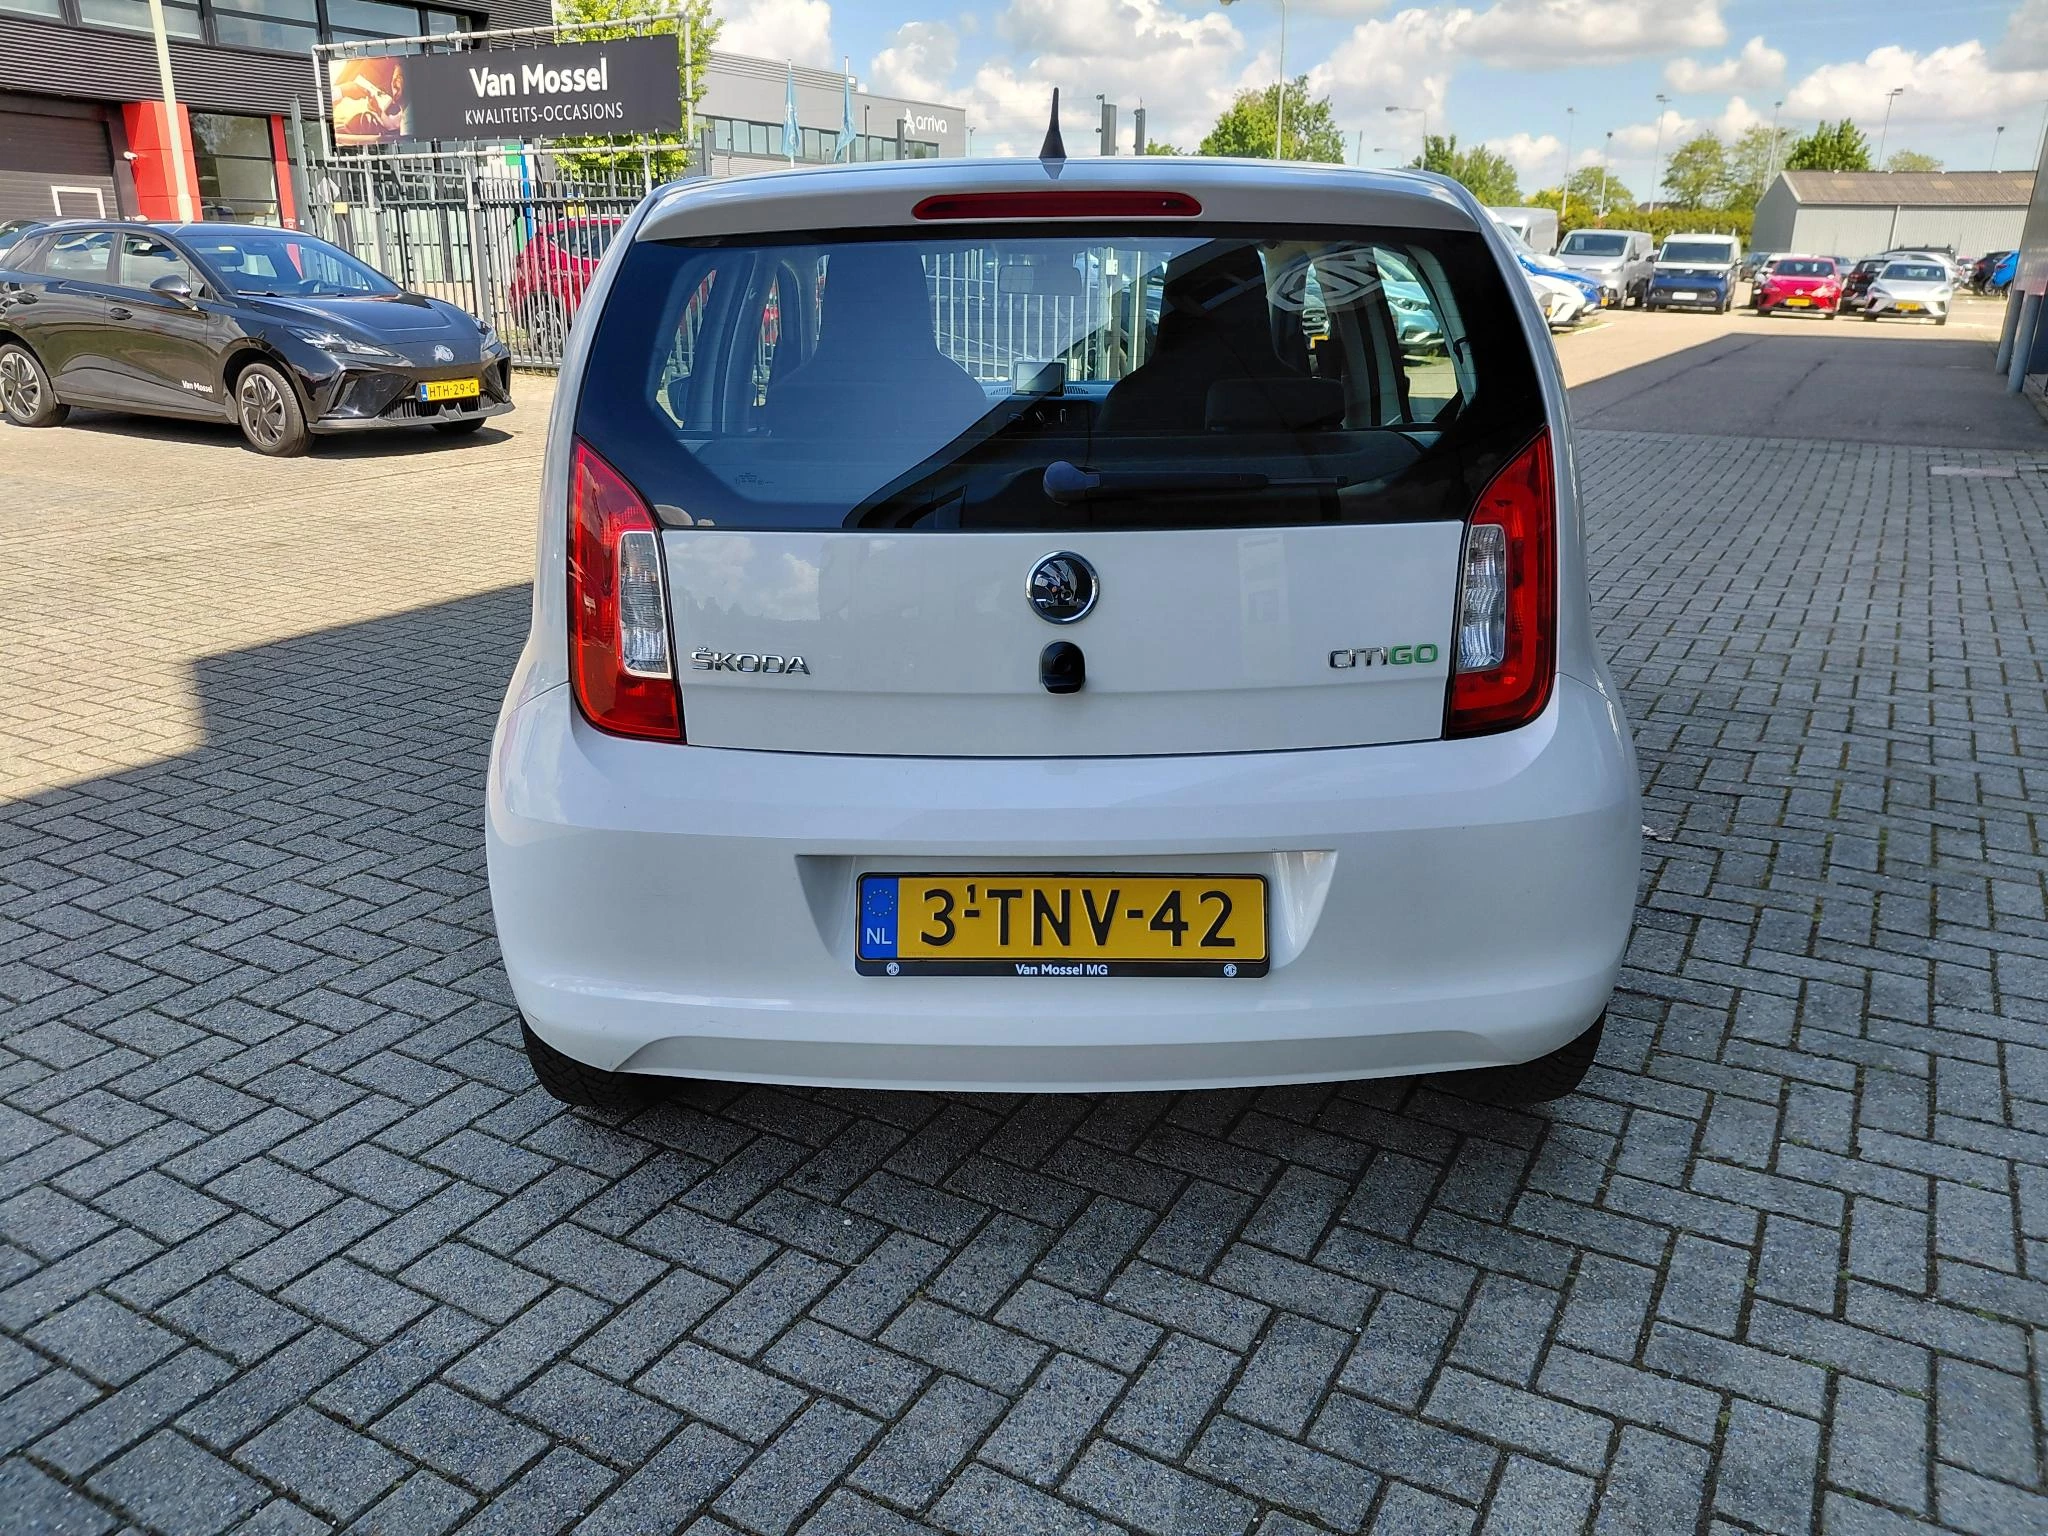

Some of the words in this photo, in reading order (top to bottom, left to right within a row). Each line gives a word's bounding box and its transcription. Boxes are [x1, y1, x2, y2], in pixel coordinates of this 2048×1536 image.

[469, 67, 516, 98] Van
[521, 57, 608, 95] Mossel
[465, 102, 624, 125] KWALITEITS-OCCASIONS
[915, 115, 948, 134] arriva
[181, 379, 194, 390] Van
[193, 382, 214, 394] Mossel
[429, 382, 476, 398] HTH-29-G
[690, 646, 811, 675] ŠKODA
[1328, 643, 1438, 668] CITIGO
[866, 928, 892, 945] NL
[1015, 963, 1038, 975] Van
[1041, 963, 1083, 976] Mossel
[1086, 964, 1108, 976] MG
